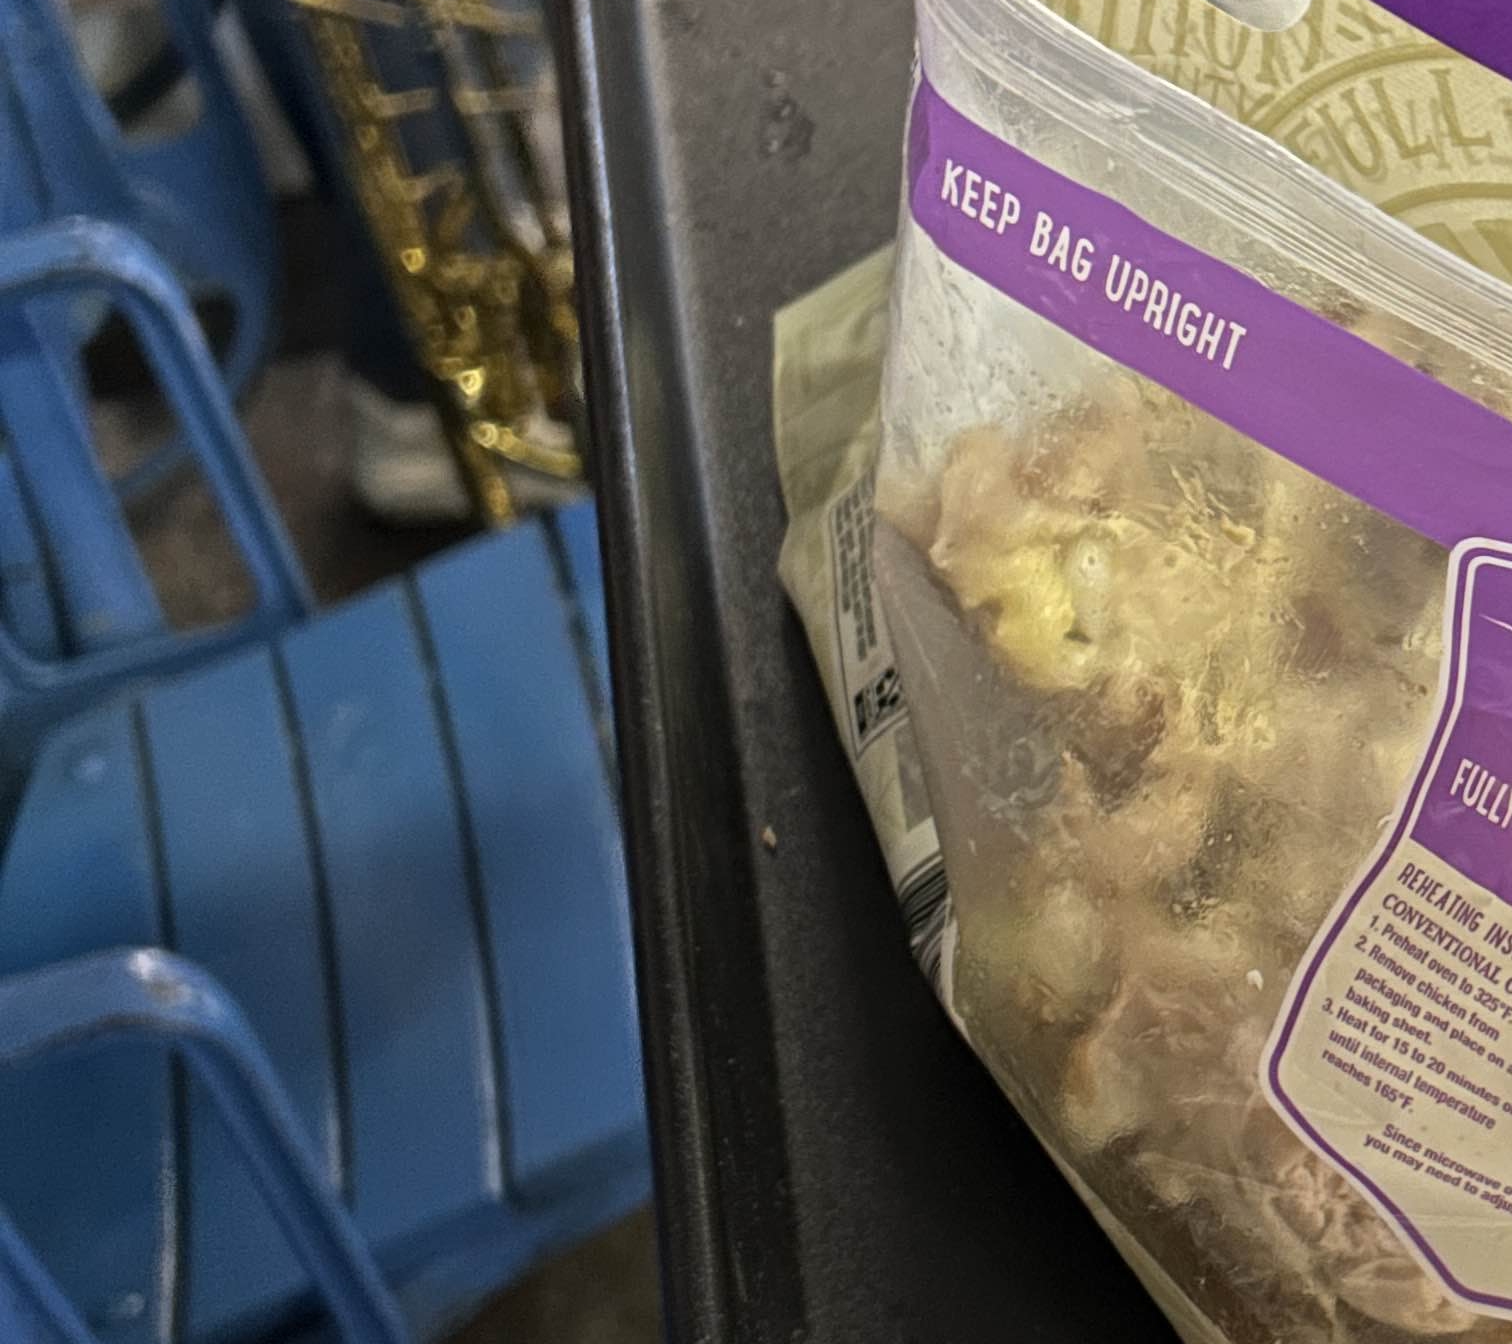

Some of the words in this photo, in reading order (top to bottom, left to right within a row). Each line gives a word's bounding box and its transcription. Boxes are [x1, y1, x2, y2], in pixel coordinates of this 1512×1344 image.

[941, 159, 1020, 236] KEEP
[1028, 211, 1095, 282] BAG
[1103, 253, 1248, 372] UPRIGHT
[1382, 893, 1501, 984] CONVENTIONAL
[1398, 863, 1485, 932] REHEATING
[1355, 935, 1367, 953] 2.
[1369, 945, 1417, 986] Remove
[1416, 981, 1467, 1020] chicken
[1467, 1012, 1500, 1041] from
[1369, 915, 1380, 933] 1.
[1381, 923, 1428, 963] Preheat
[1427, 960, 1458, 984] oven
[1459, 977, 1473, 995] to
[1322, 997, 1334, 1015] 3.
[1337, 1006, 1367, 1034] Heat
[1369, 1024, 1390, 1044] for
[1392, 1037, 1409, 1056] 15
[1410, 1046, 1425, 1063] to
[1426, 1056, 1446, 1074] 20
[1446, 1067, 1500, 1106] minutes
[1345, 986, 1390, 1025] baking
[1392, 1015, 1432, 1045] sheet.
[1355, 967, 1421, 1018] packaging
[1424, 1008, 1449, 1032] and
[1449, 1025, 1485, 1056] place
[1487, 1052, 1505, 1069] on
[1322, 1048, 1372, 1087] reaches
[1329, 1030, 1359, 1054] until
[1360, 1046, 1412, 1084] internal
[1413, 1075, 1497, 1130] temperature
[1363, 1133, 1390, 1156] you
[1392, 1146, 1424, 1172] may
[1425, 1164, 1462, 1188] need
[1463, 1180, 1479, 1196] to
[1382, 1122, 1422, 1154] Since
[1423, 1144, 1502, 1191] microwave
